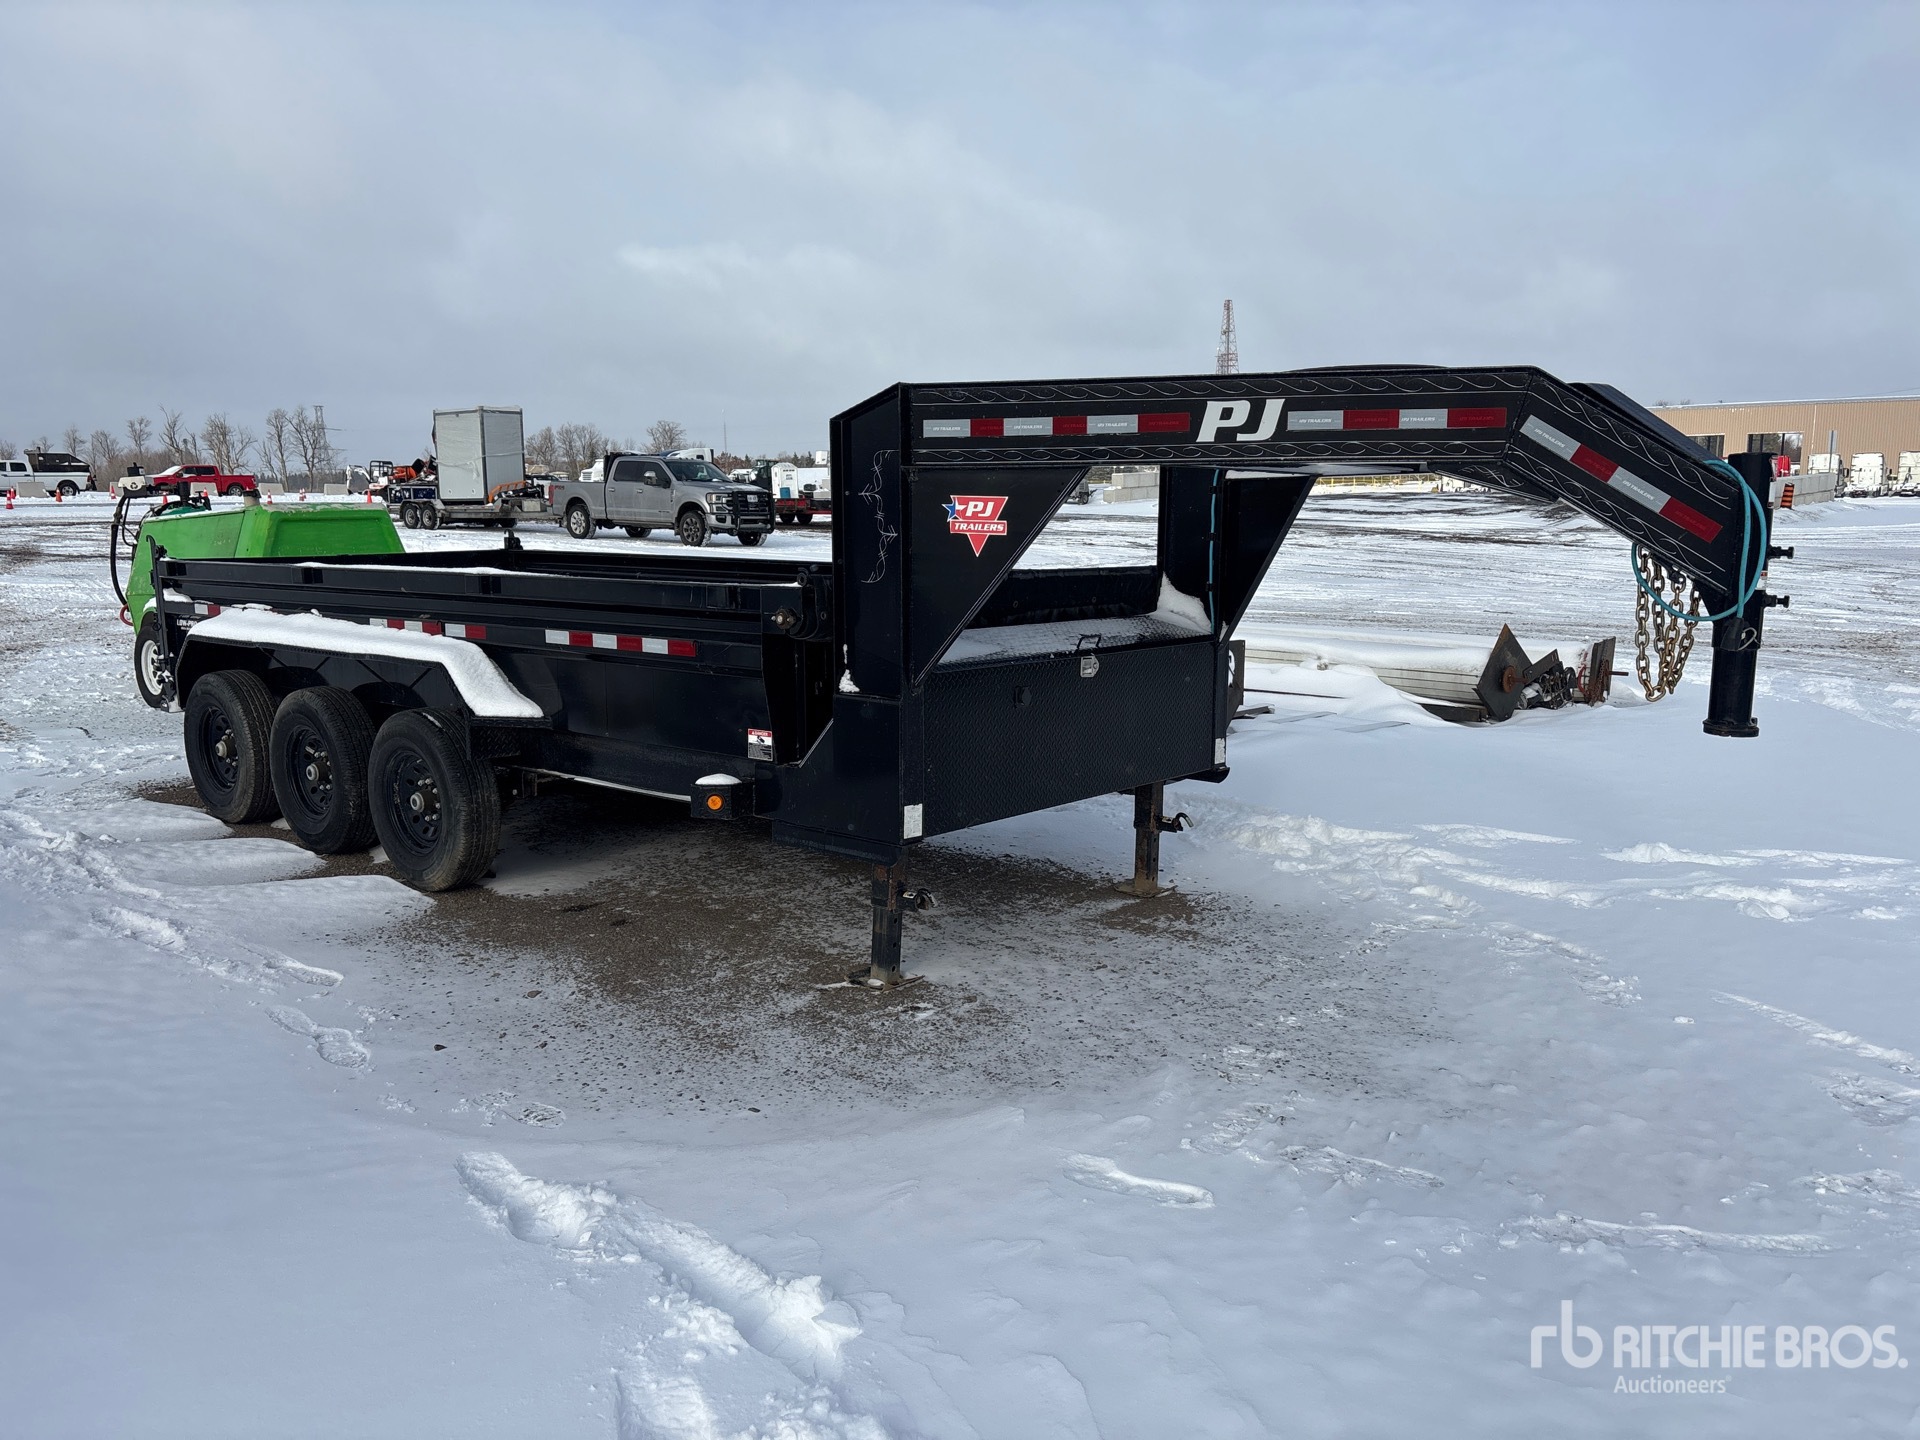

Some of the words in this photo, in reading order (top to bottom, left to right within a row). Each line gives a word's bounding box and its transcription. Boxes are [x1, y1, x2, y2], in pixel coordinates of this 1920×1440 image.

[1196, 398, 1286, 442] PJ
[965, 501, 995, 517] PJ
[954, 523, 1005, 532] TRAILERS
